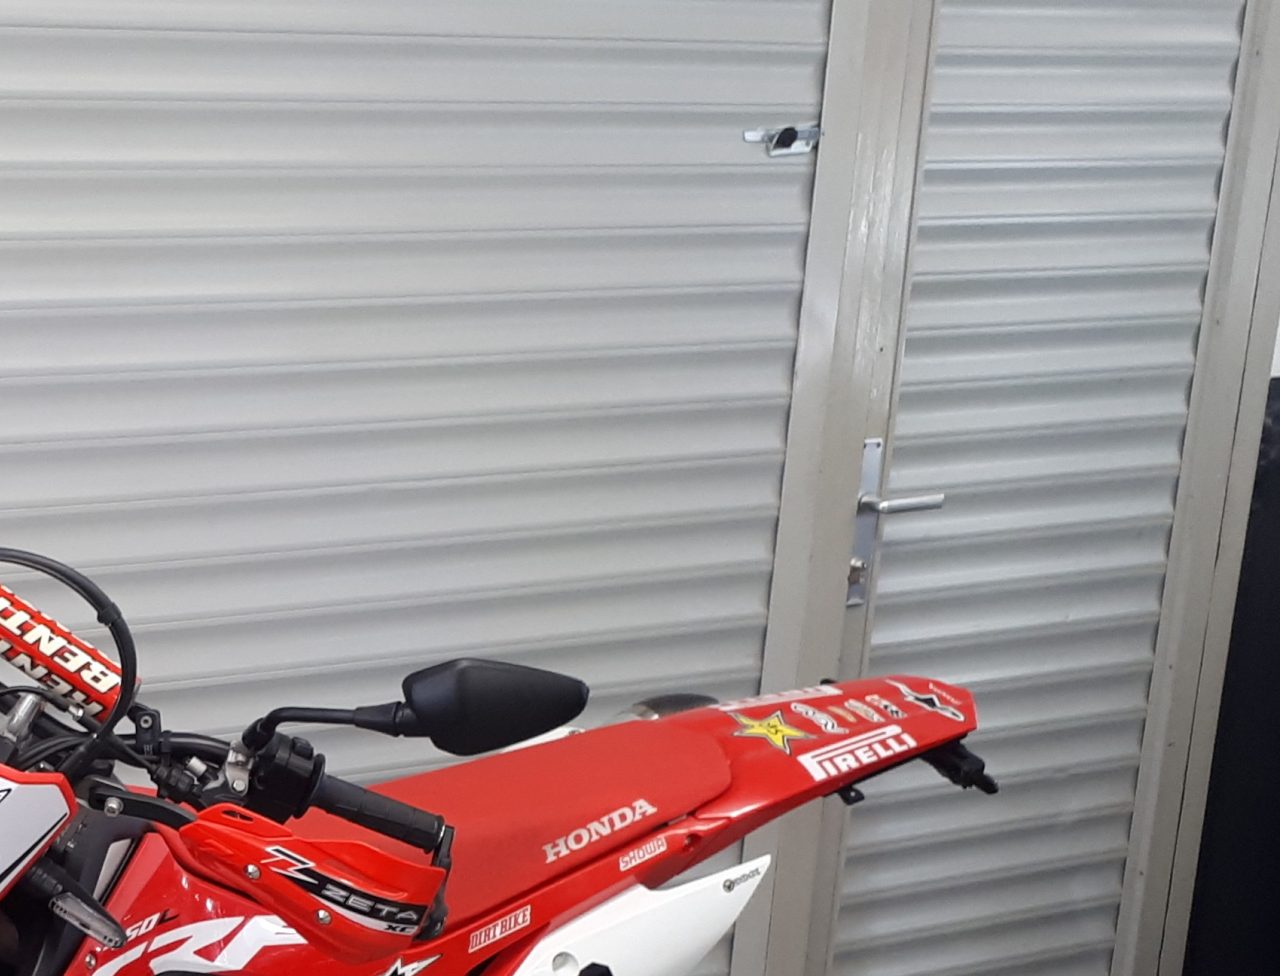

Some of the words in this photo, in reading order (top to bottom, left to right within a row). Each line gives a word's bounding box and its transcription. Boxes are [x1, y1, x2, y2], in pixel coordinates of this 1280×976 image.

[797, 724, 917, 782] PIRELLI
[542, 798, 657, 864] HONDA
[620, 837, 666, 869] SHOWA
[321, 883, 418, 922] ZETA
[471, 923, 501, 950] DIRT
[501, 908, 529, 941] BIKE
